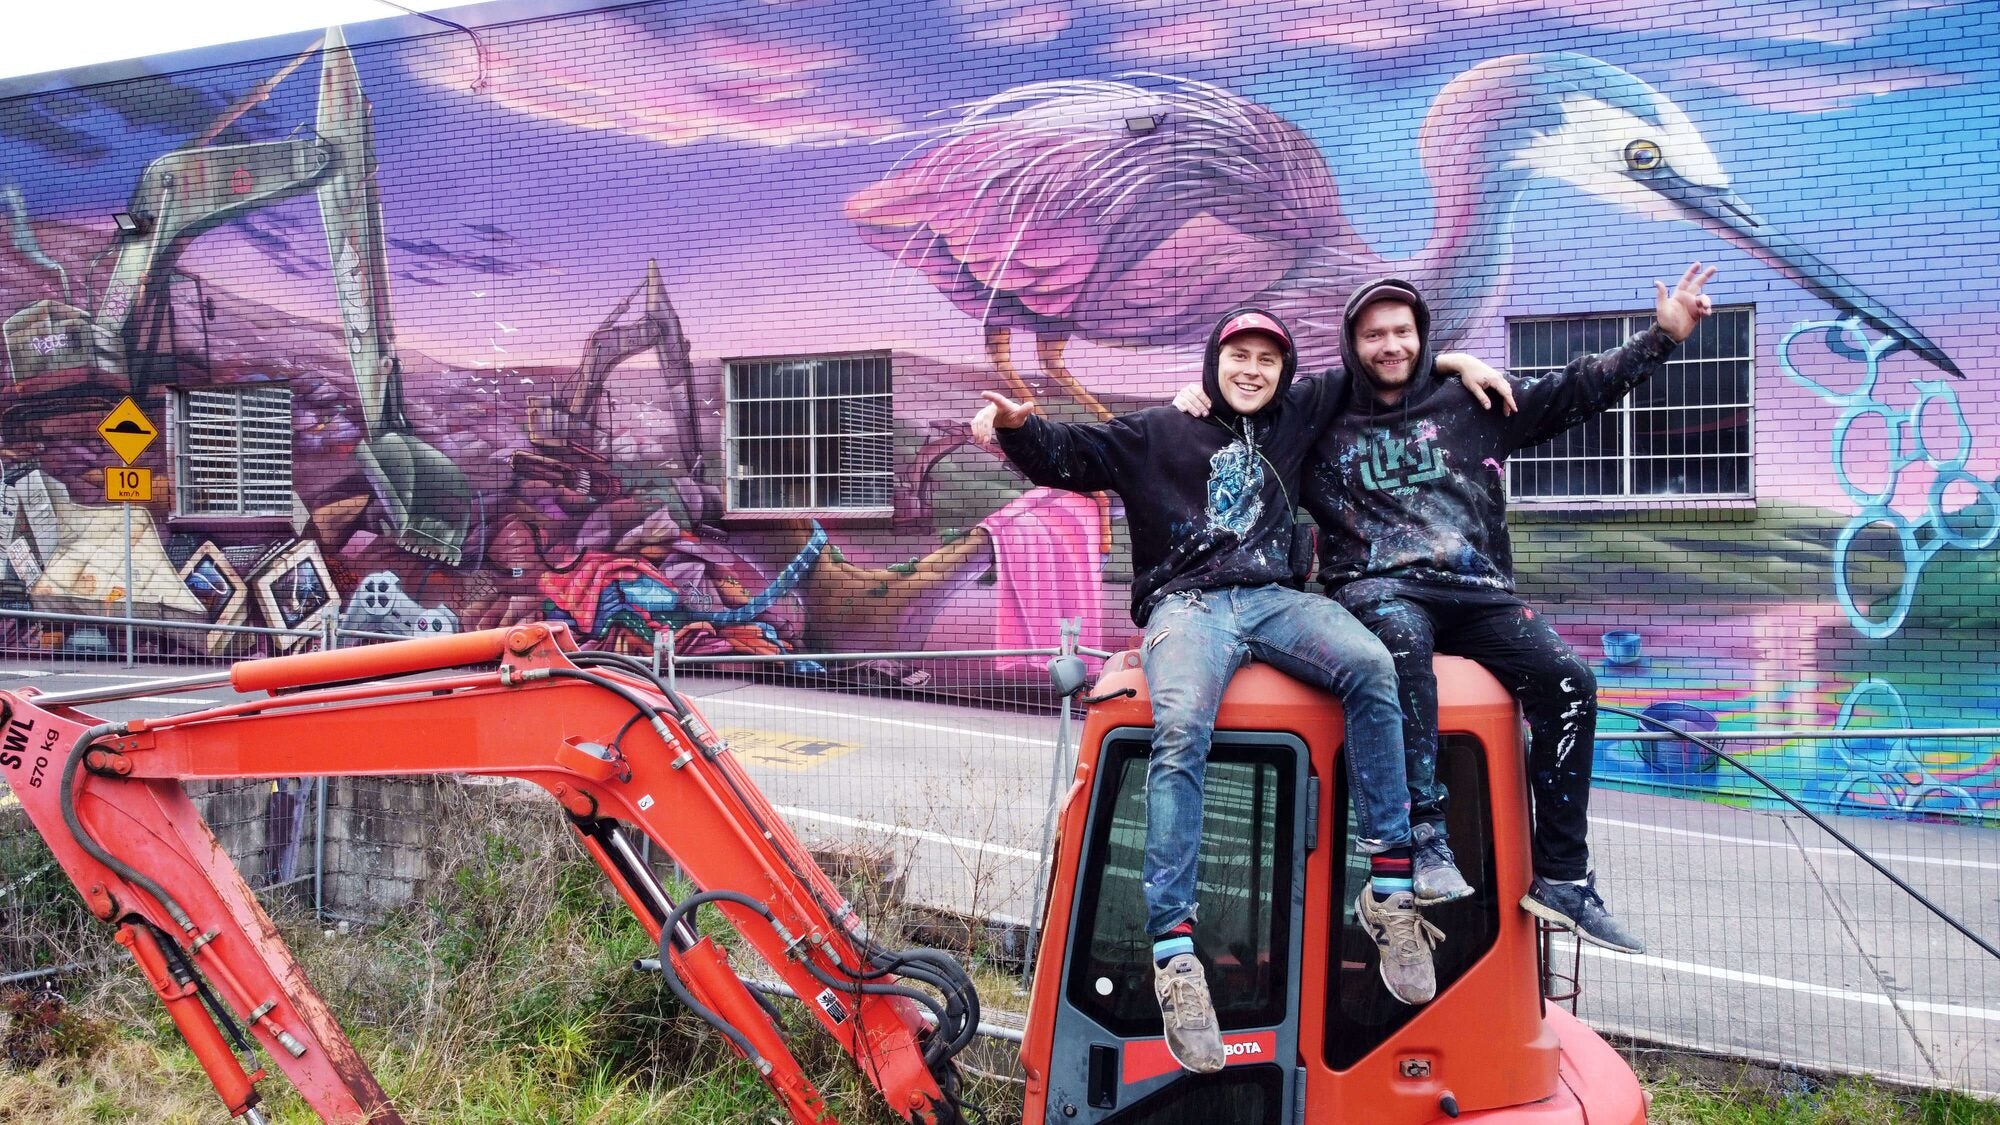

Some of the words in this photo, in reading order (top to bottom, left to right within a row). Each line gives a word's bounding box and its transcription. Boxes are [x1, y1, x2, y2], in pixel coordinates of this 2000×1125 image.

[119, 471, 139, 489] 10
[118, 490, 140, 498] km/h
[0, 719, 35, 770] SWL
[29, 756, 49, 788] 570
[40, 728, 60, 752] kg
[1223, 1042, 1262, 1056] BOTA
